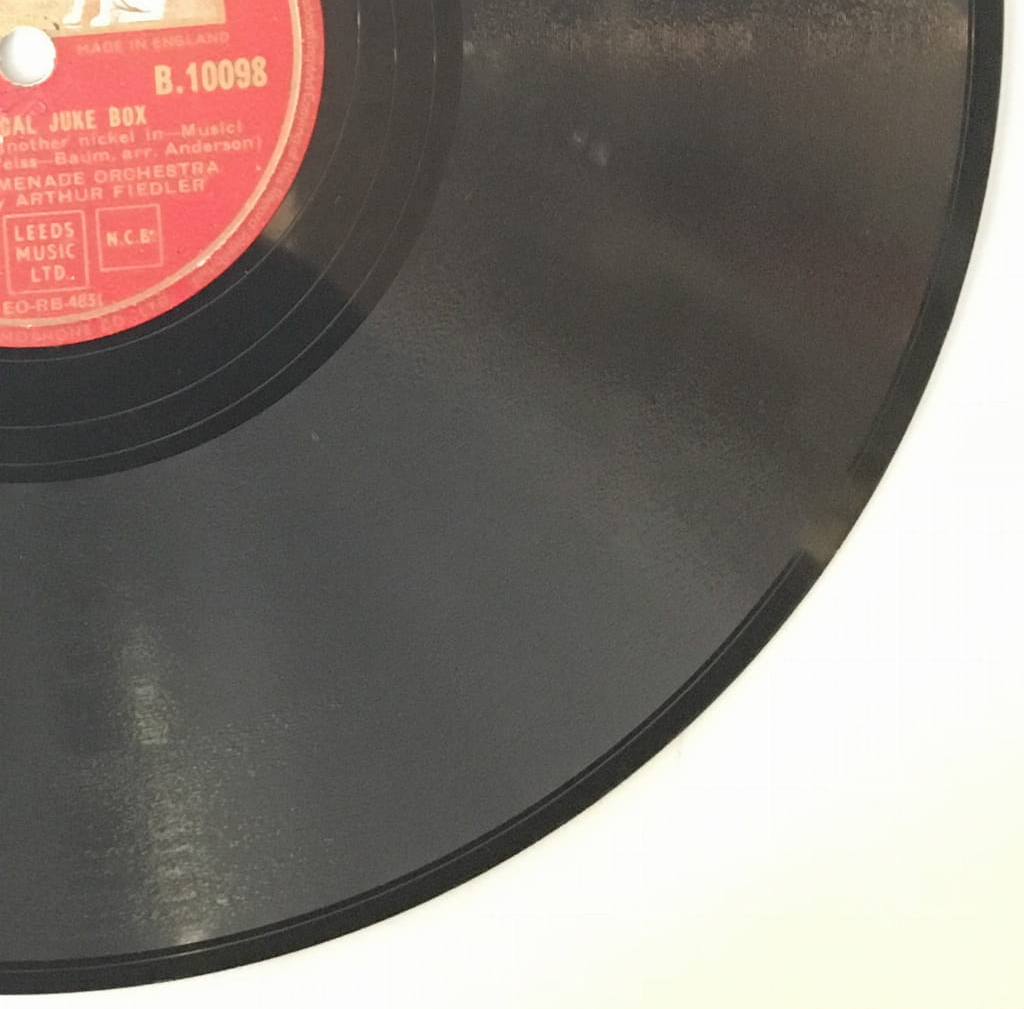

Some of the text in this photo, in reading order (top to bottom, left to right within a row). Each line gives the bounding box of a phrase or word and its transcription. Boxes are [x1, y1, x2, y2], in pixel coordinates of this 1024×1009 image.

[76, 31, 230, 56] MADE IN ENGLAND
[154, 56, 268, 96] B.10098
[49, 110, 97, 132] JUKE
[108, 105, 147, 128] BOX
[77, 129, 136, 147] nickel
[93, 160, 221, 183] ORCHESTRA
[15, 187, 104, 208] ARTHUR
[113, 178, 206, 199] FIEDLER
[14, 221, 75, 242] LEEDS
[16, 243, 76, 262] MUSIC
